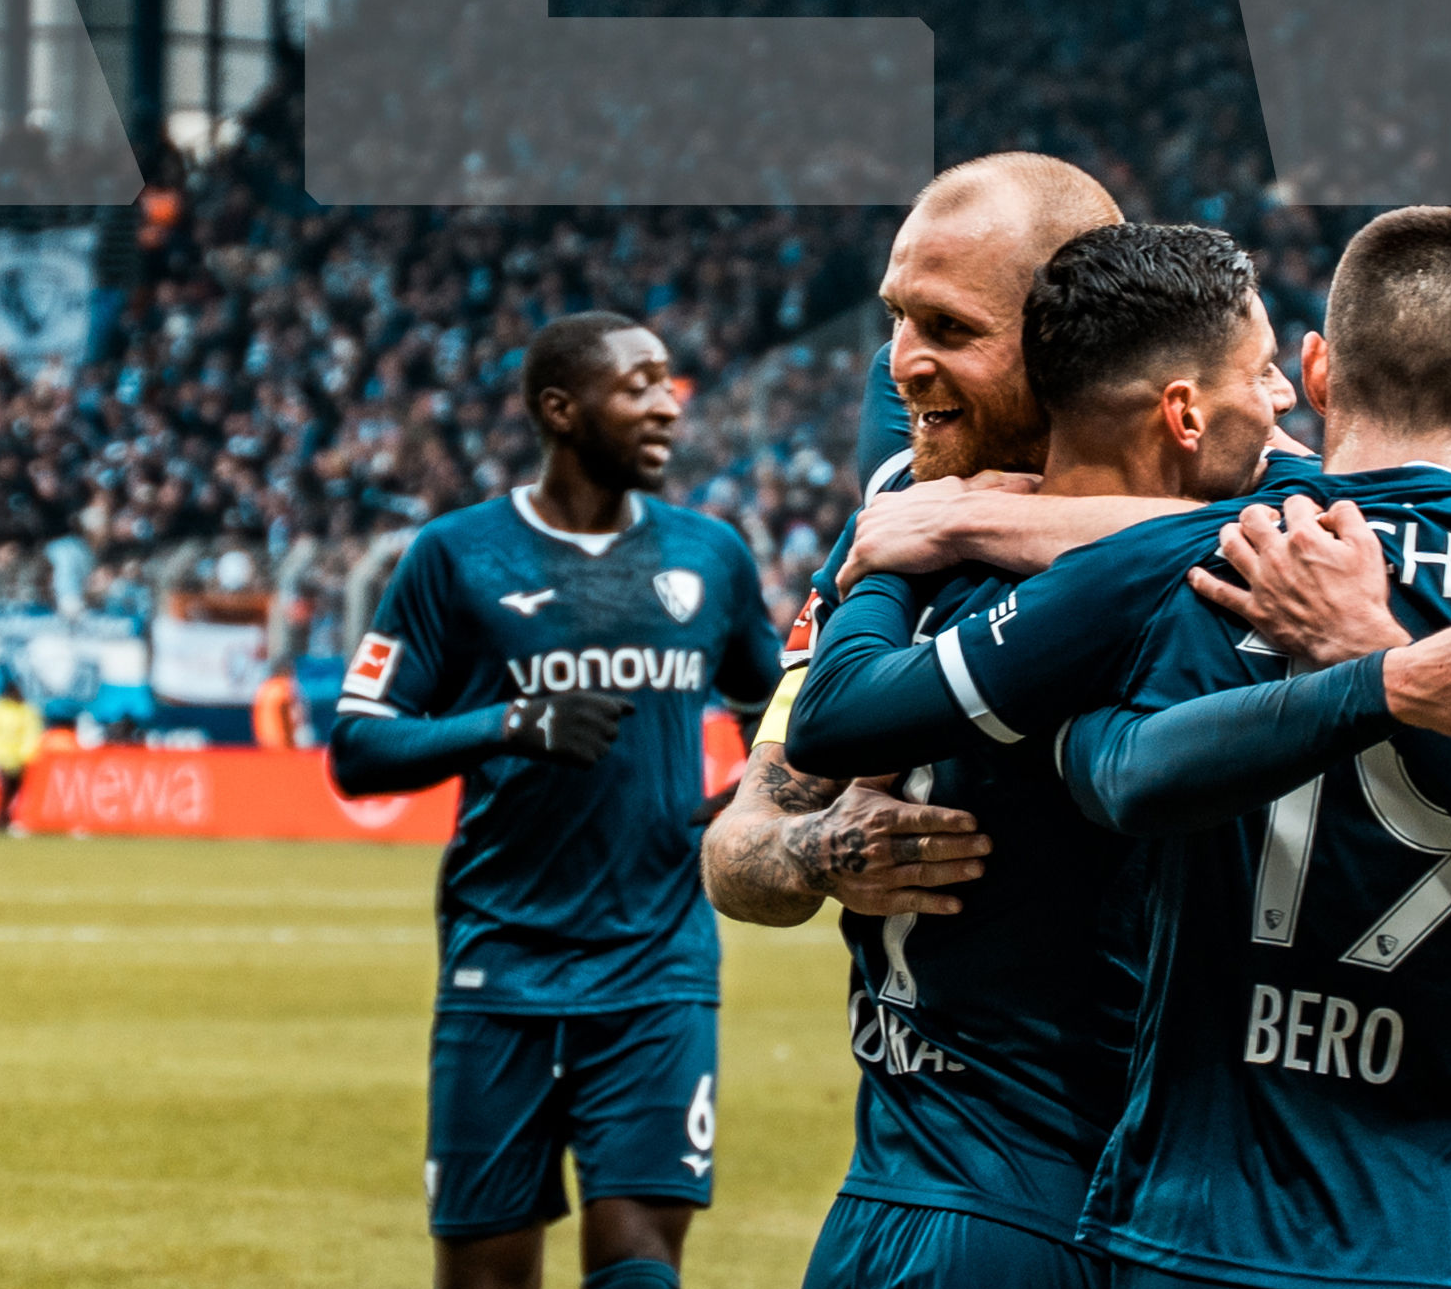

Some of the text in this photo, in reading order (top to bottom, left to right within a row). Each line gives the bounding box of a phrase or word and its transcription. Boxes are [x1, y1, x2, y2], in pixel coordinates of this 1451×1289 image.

[508, 647, 703, 695] VONOVIA
[1244, 984, 1405, 1085] BERO
[687, 1073, 715, 1151] 6
